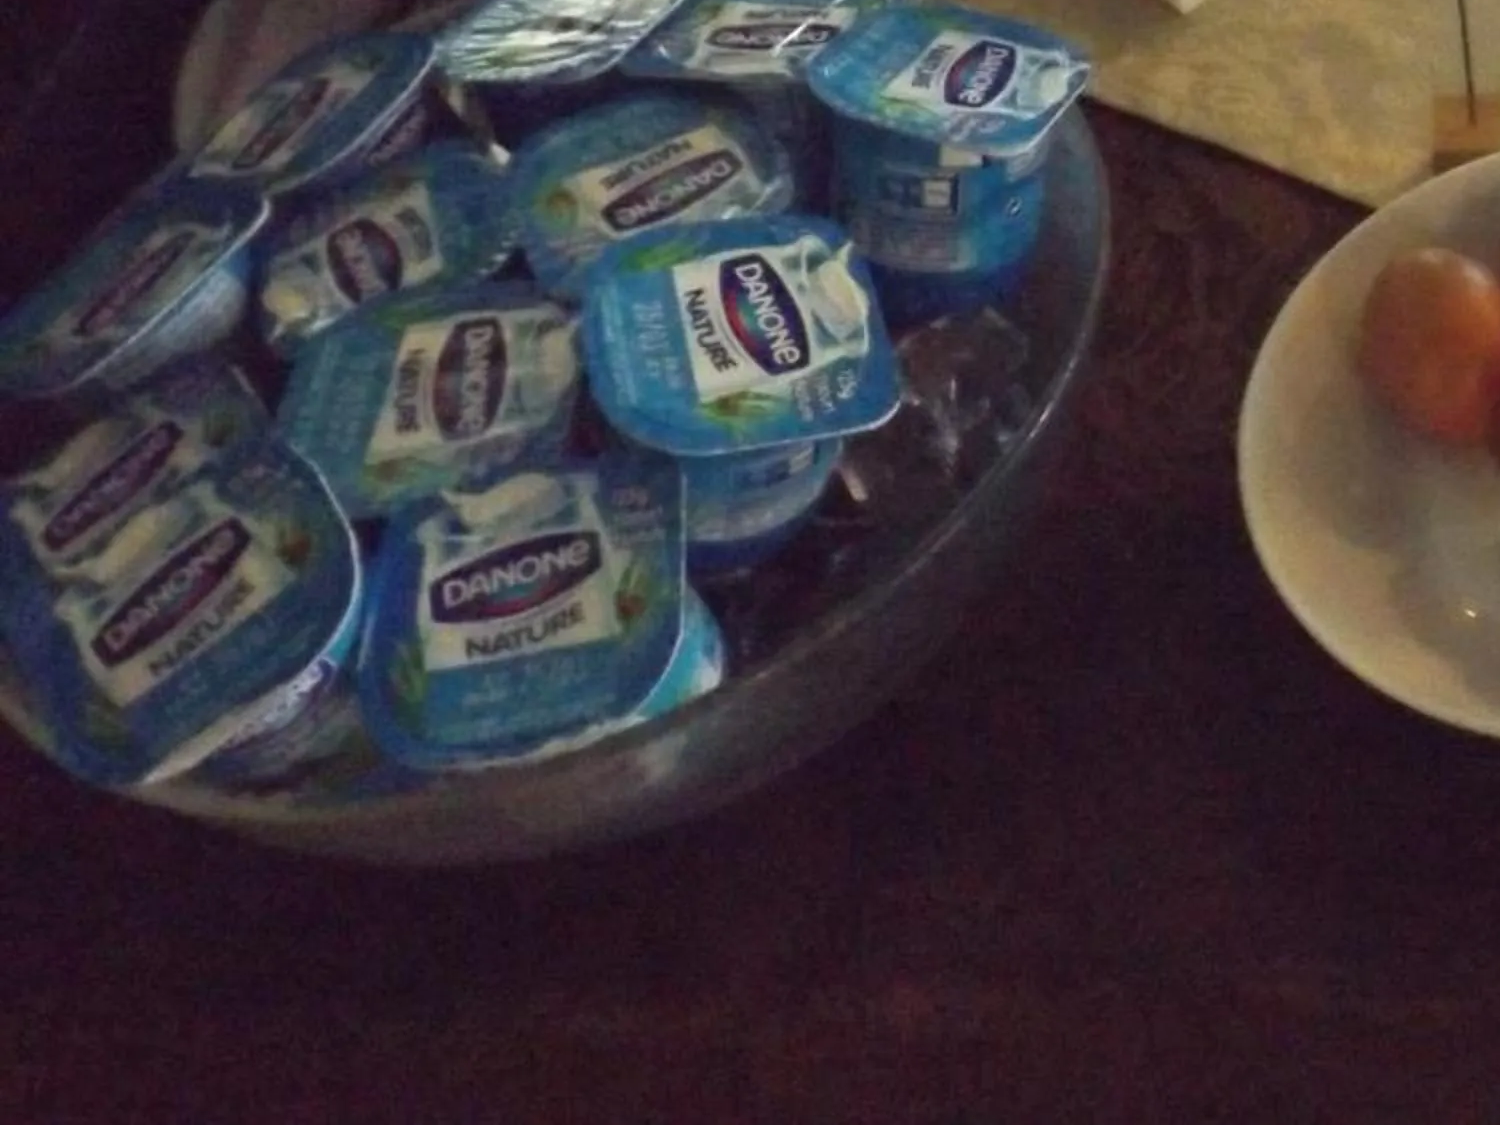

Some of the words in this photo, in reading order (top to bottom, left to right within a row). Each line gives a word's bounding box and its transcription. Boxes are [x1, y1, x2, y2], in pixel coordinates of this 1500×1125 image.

[683, 287, 739, 374] NATURE
[734, 261, 802, 366] DANONE
[441, 538, 591, 610] DANONE
[464, 601, 587, 660] NATURE
